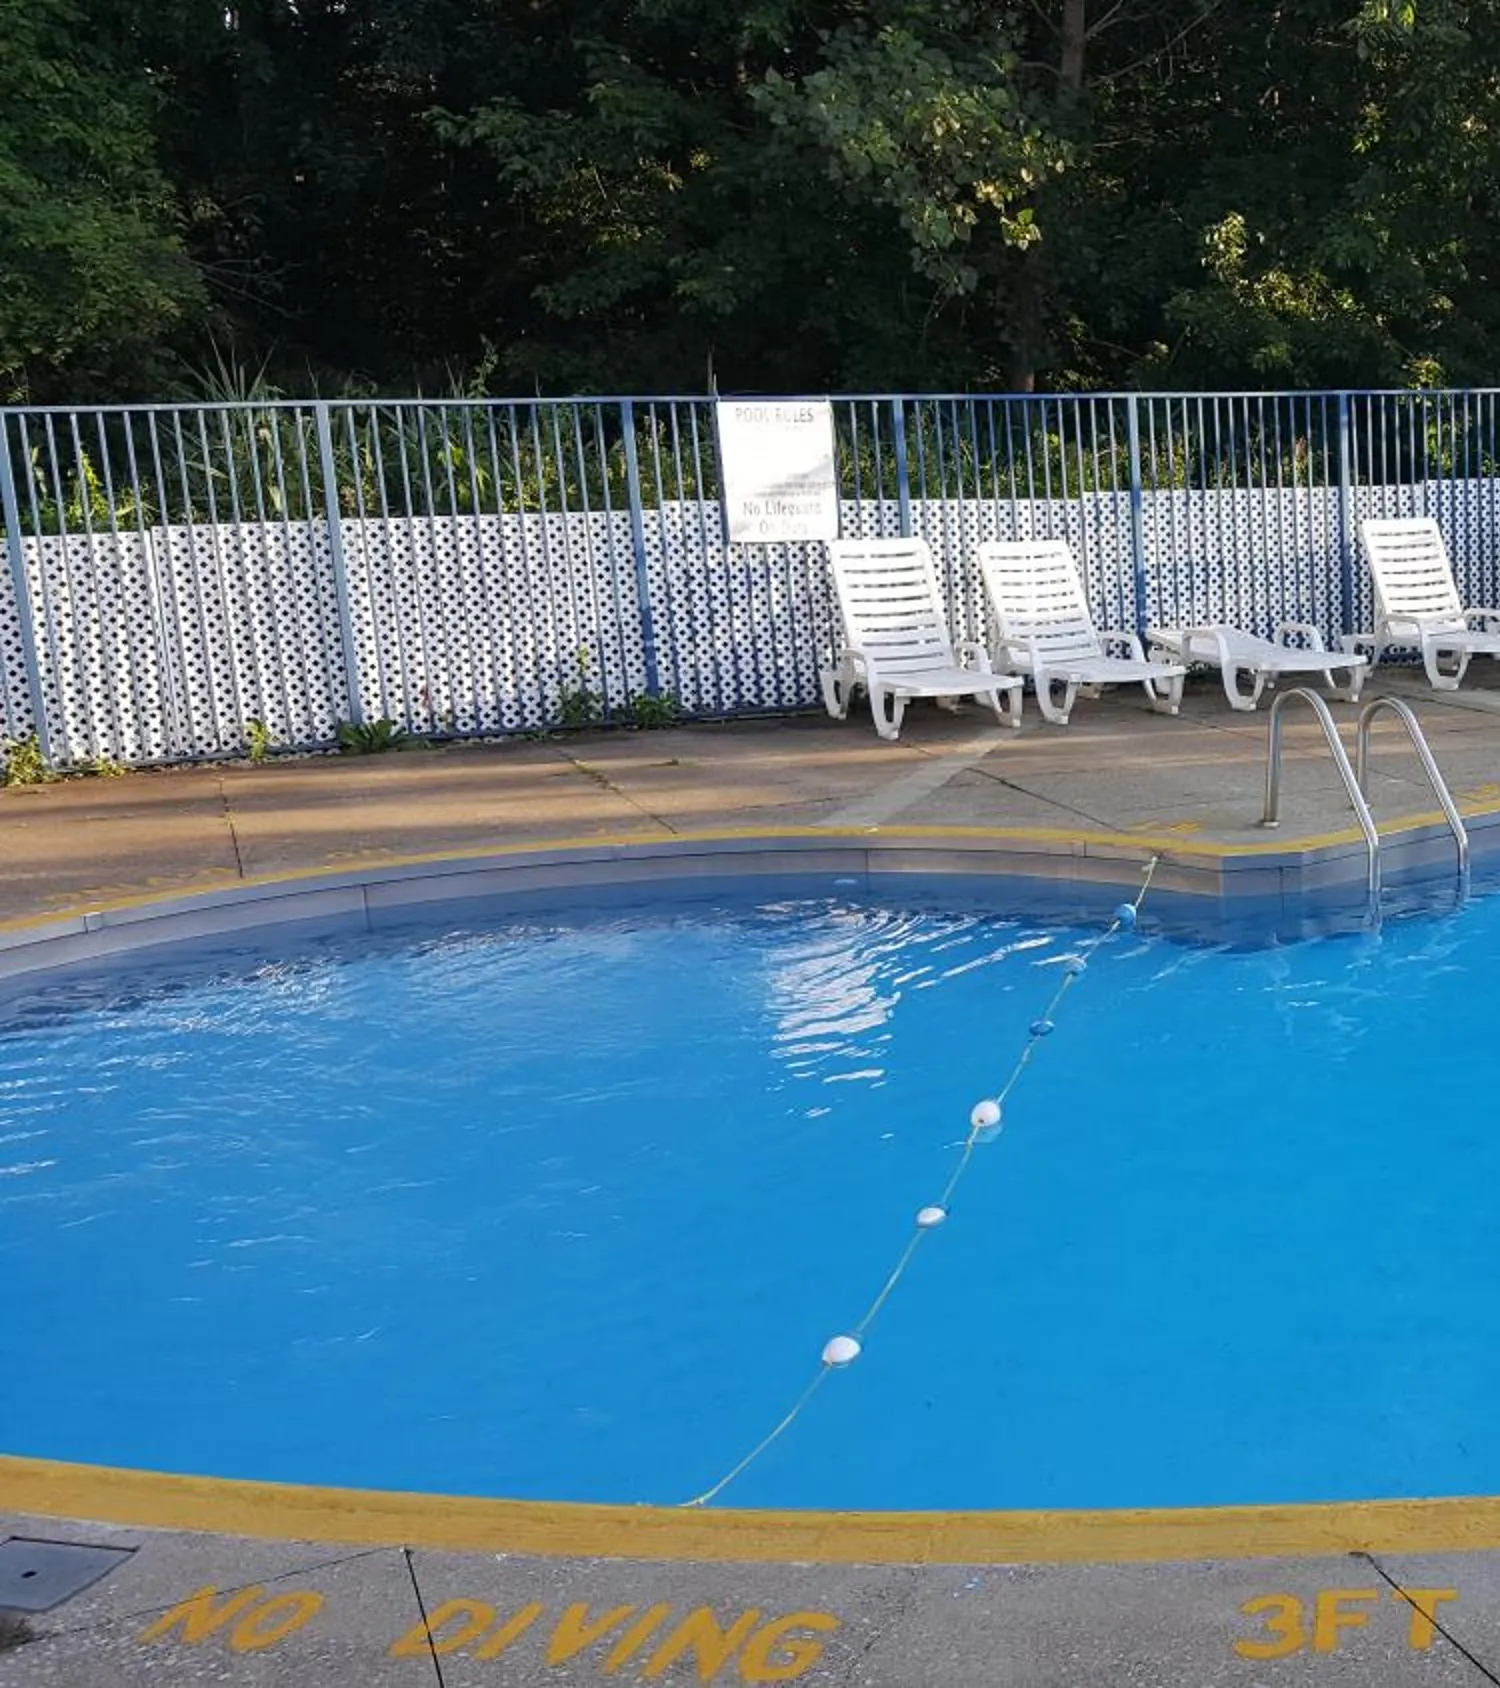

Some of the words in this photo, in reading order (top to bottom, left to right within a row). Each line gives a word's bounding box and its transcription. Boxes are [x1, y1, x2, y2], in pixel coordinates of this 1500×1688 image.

[743, 501, 760, 516] No
[135, 1583, 324, 1654] NO
[387, 1597, 843, 1683] DIVING
[1231, 1588, 1460, 1662] 3FT
